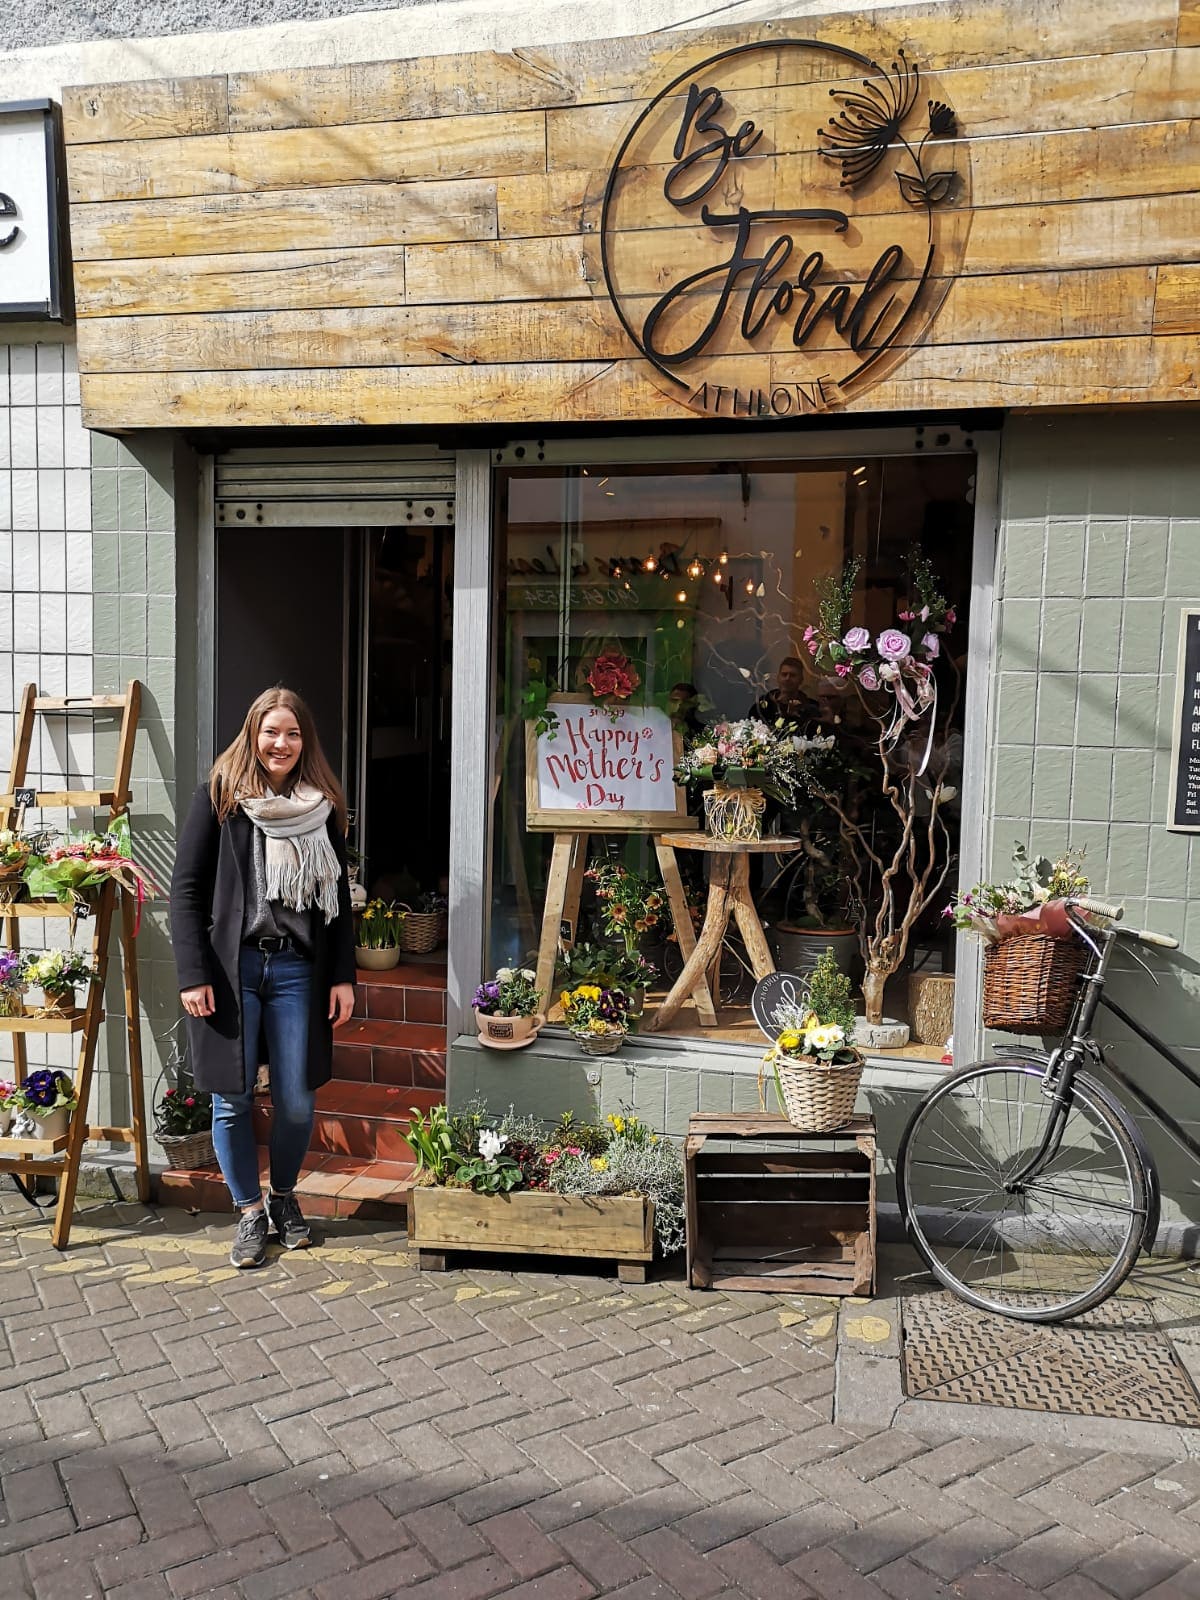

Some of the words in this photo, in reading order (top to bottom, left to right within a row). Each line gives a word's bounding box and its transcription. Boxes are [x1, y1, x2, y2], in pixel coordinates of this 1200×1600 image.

[664, 83, 763, 206] Be
[642, 204, 901, 364] Floral
[565, 717, 640, 755] Happy
[545, 748, 665, 790] Mother's
[586, 783, 626, 810] Day
[1095, 1373, 1150, 1400] FOUNDRY
